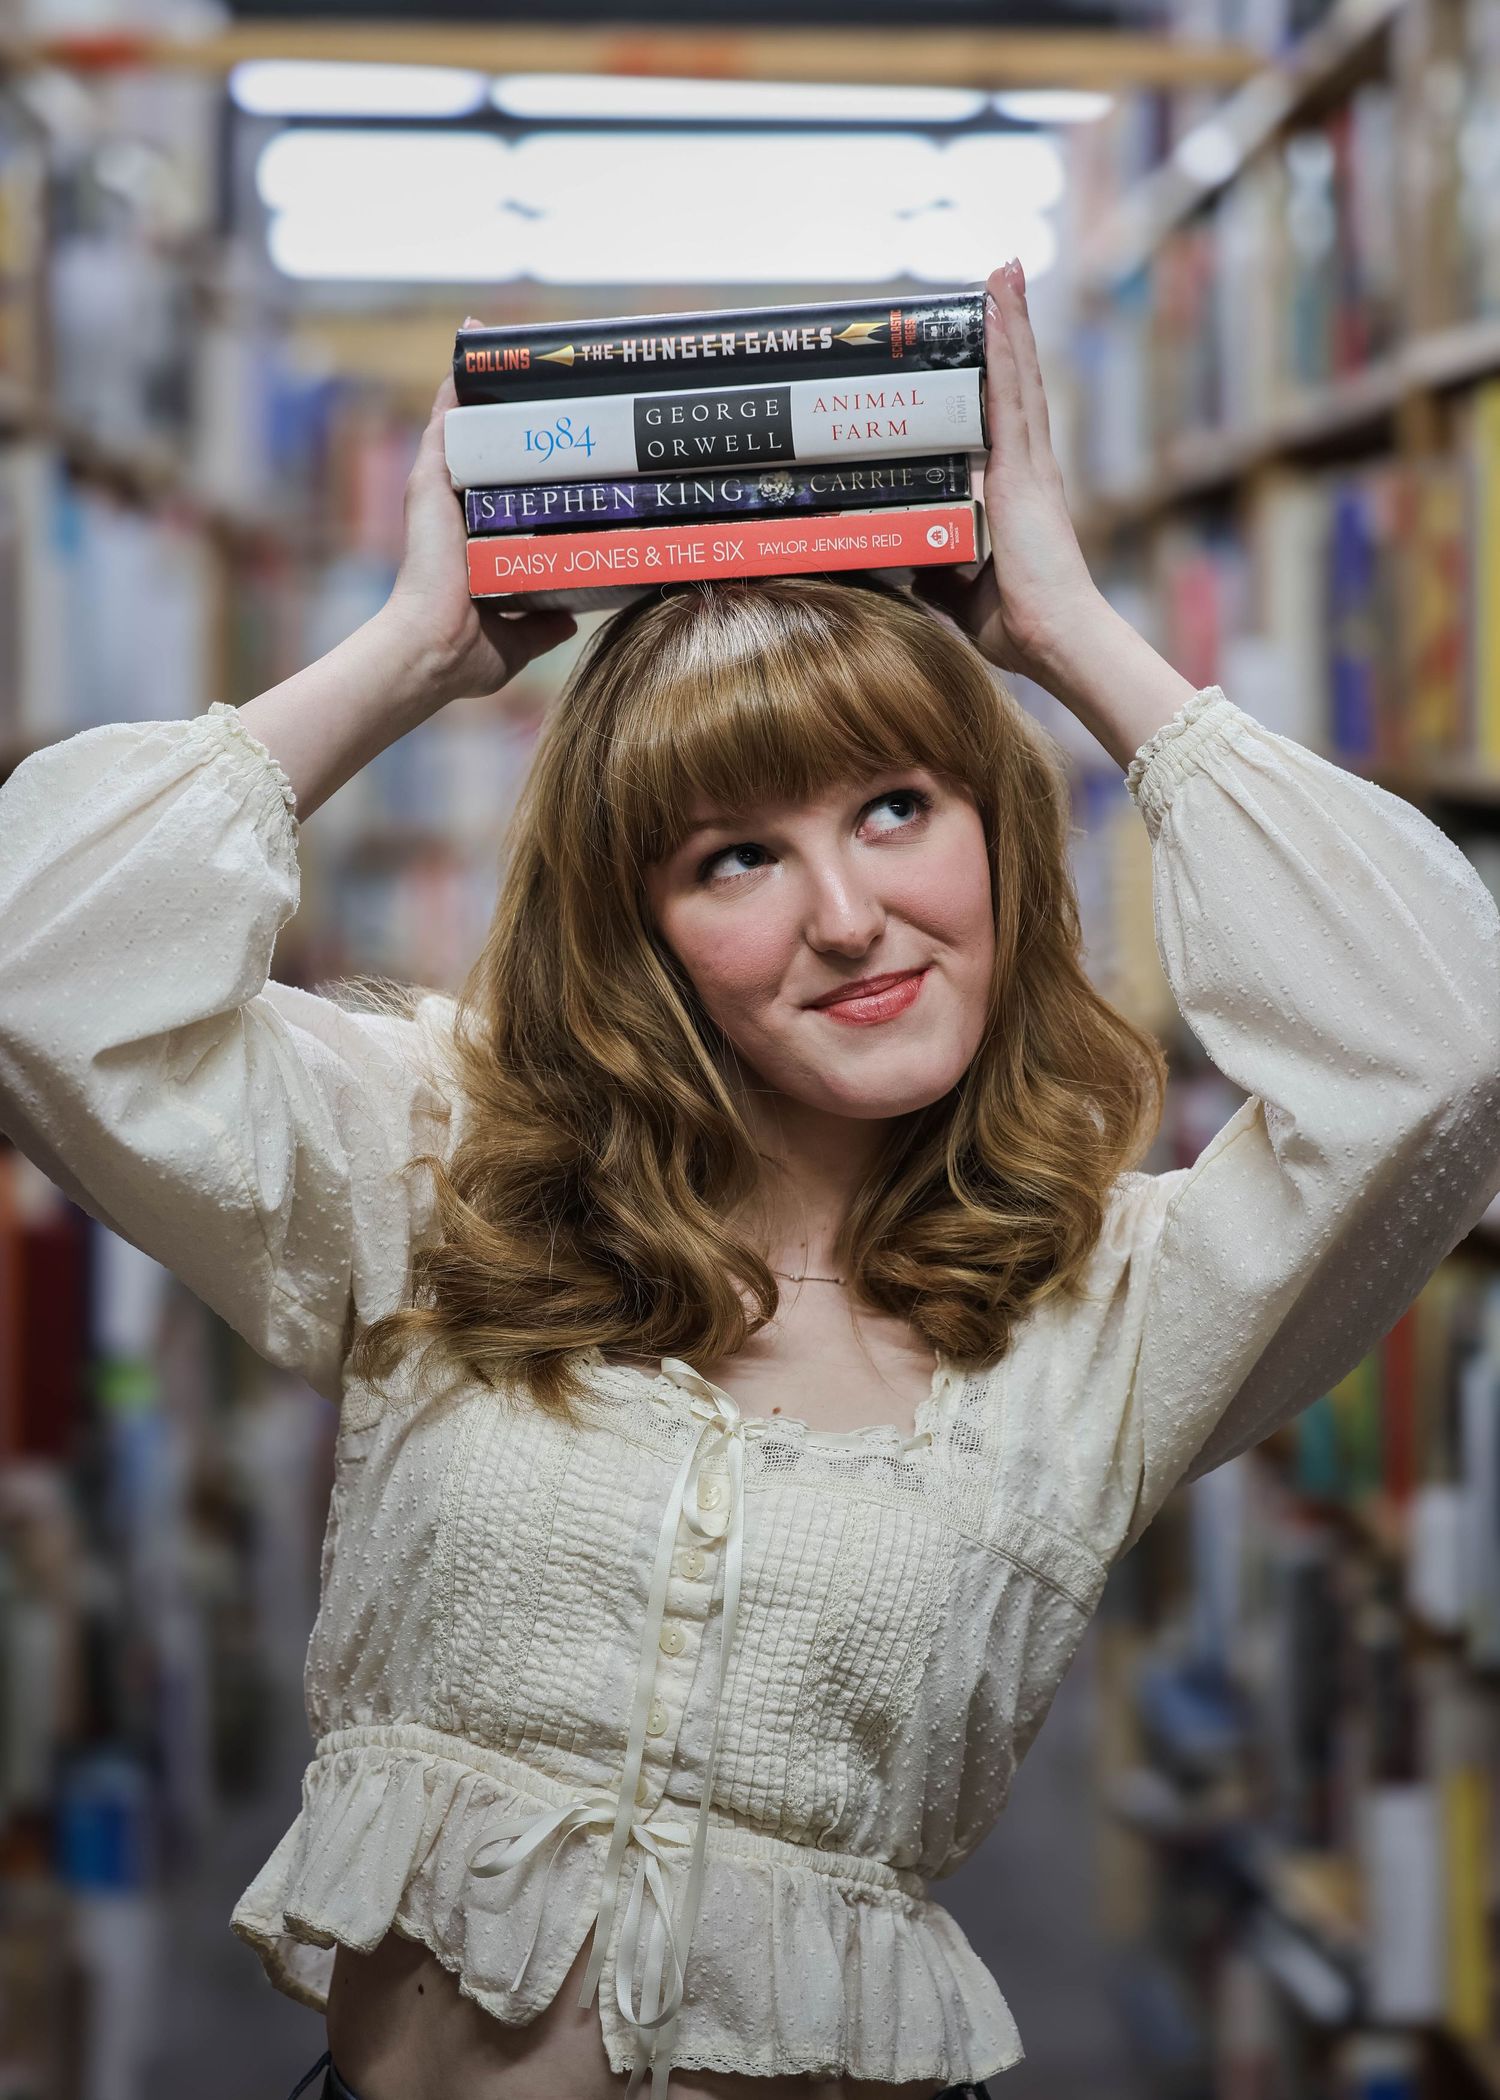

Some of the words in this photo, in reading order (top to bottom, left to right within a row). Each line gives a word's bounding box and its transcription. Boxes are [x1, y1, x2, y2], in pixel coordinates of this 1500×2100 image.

[581, 344, 614, 362] THE
[622, 333, 736, 363] HUNGER
[744, 327, 833, 354] GAMES
[890, 309, 903, 359] SCHOLASTIC
[905, 318, 917, 346] PRESS
[465, 348, 531, 373] COLLINS
[645, 399, 779, 426] GEORGE
[812, 390, 925, 414] ANIMAL
[957, 394, 967, 423] HMH
[524, 416, 597, 463] 1984
[832, 420, 909, 441] FARM
[647, 432, 783, 458] ORWELL
[809, 468, 915, 493] CARRIE
[481, 485, 636, 519] STEPHEN
[656, 479, 745, 508] KING
[757, 539, 808, 556] TAYLOR
[811, 536, 868, 552] JENKINS
[872, 533, 903, 548] REID
[495, 552, 558, 577] DAISY
[563, 547, 639, 573] JONES
[645, 546, 662, 567] &
[665, 543, 706, 565] THE
[713, 540, 745, 562] SIX
